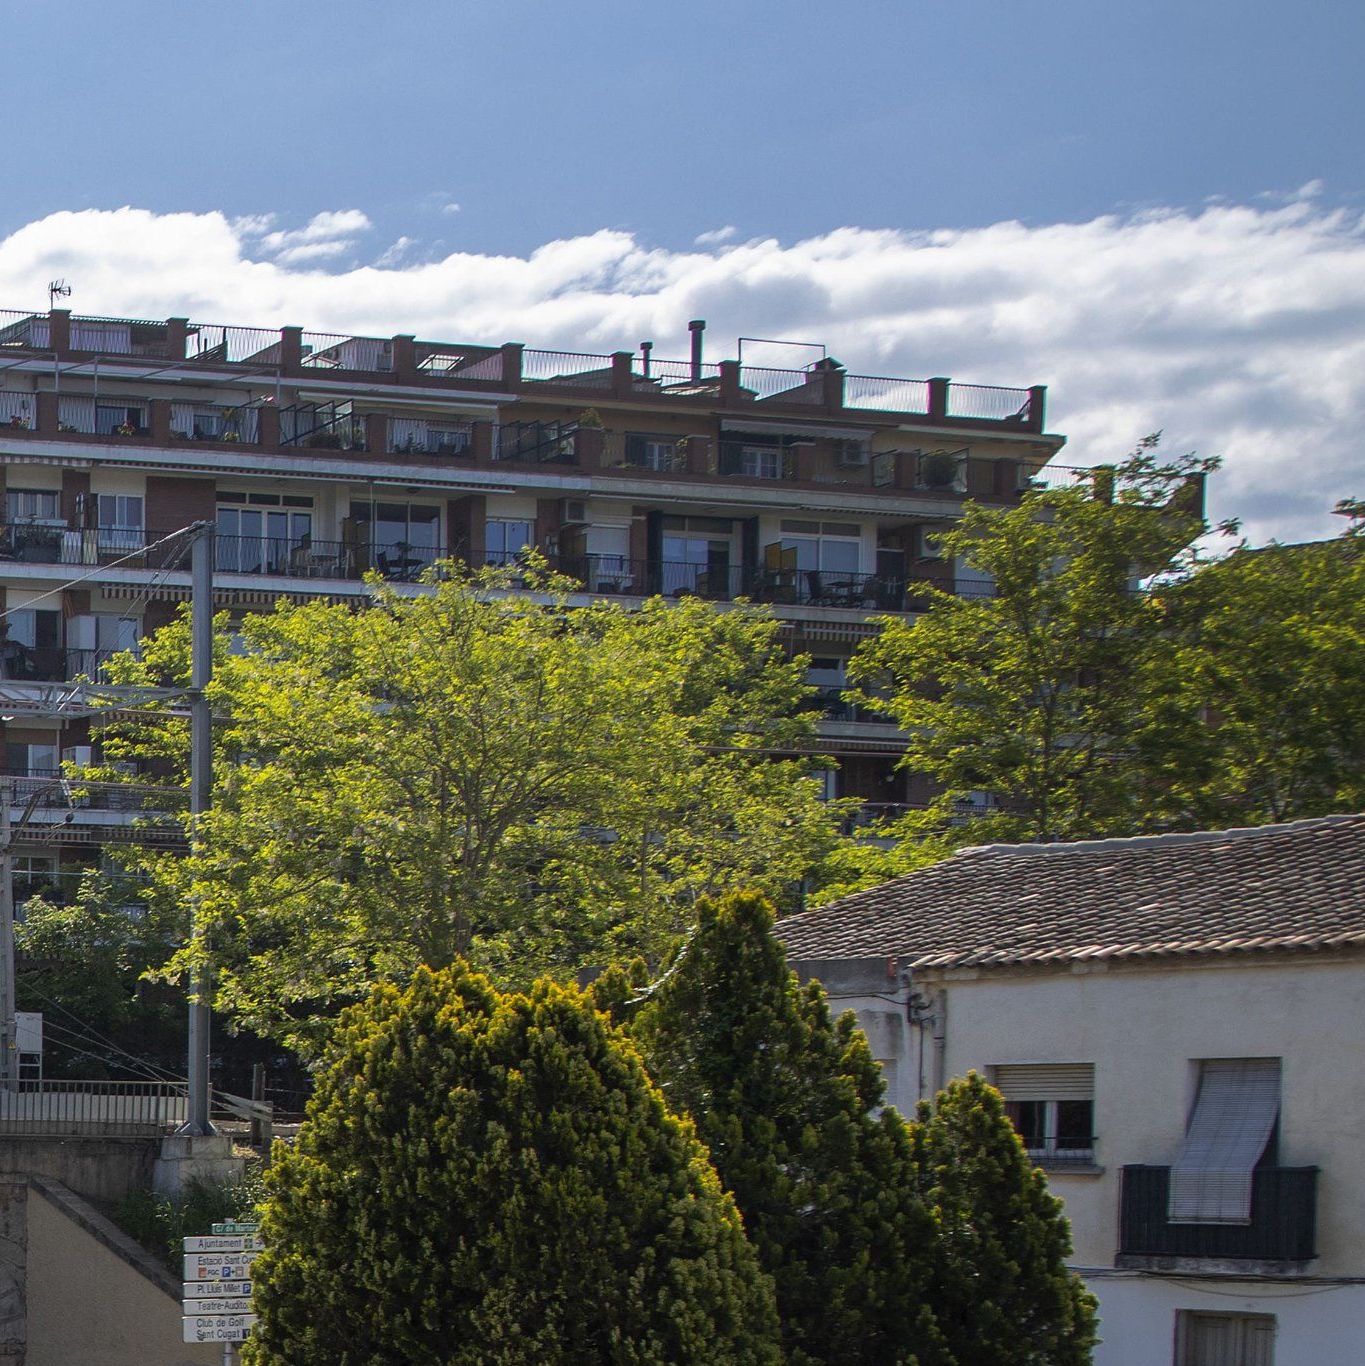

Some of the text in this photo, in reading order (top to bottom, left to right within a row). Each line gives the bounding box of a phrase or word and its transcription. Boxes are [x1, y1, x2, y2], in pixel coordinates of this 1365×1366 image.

[198, 1239, 242, 1250] Ajuntament
[197, 1256, 222, 1266] Estació
[225, 1255, 240, 1265] Sant
[196, 1317, 244, 1328] Club de Golf
[196, 1329, 240, 1340] Sant Cugat
